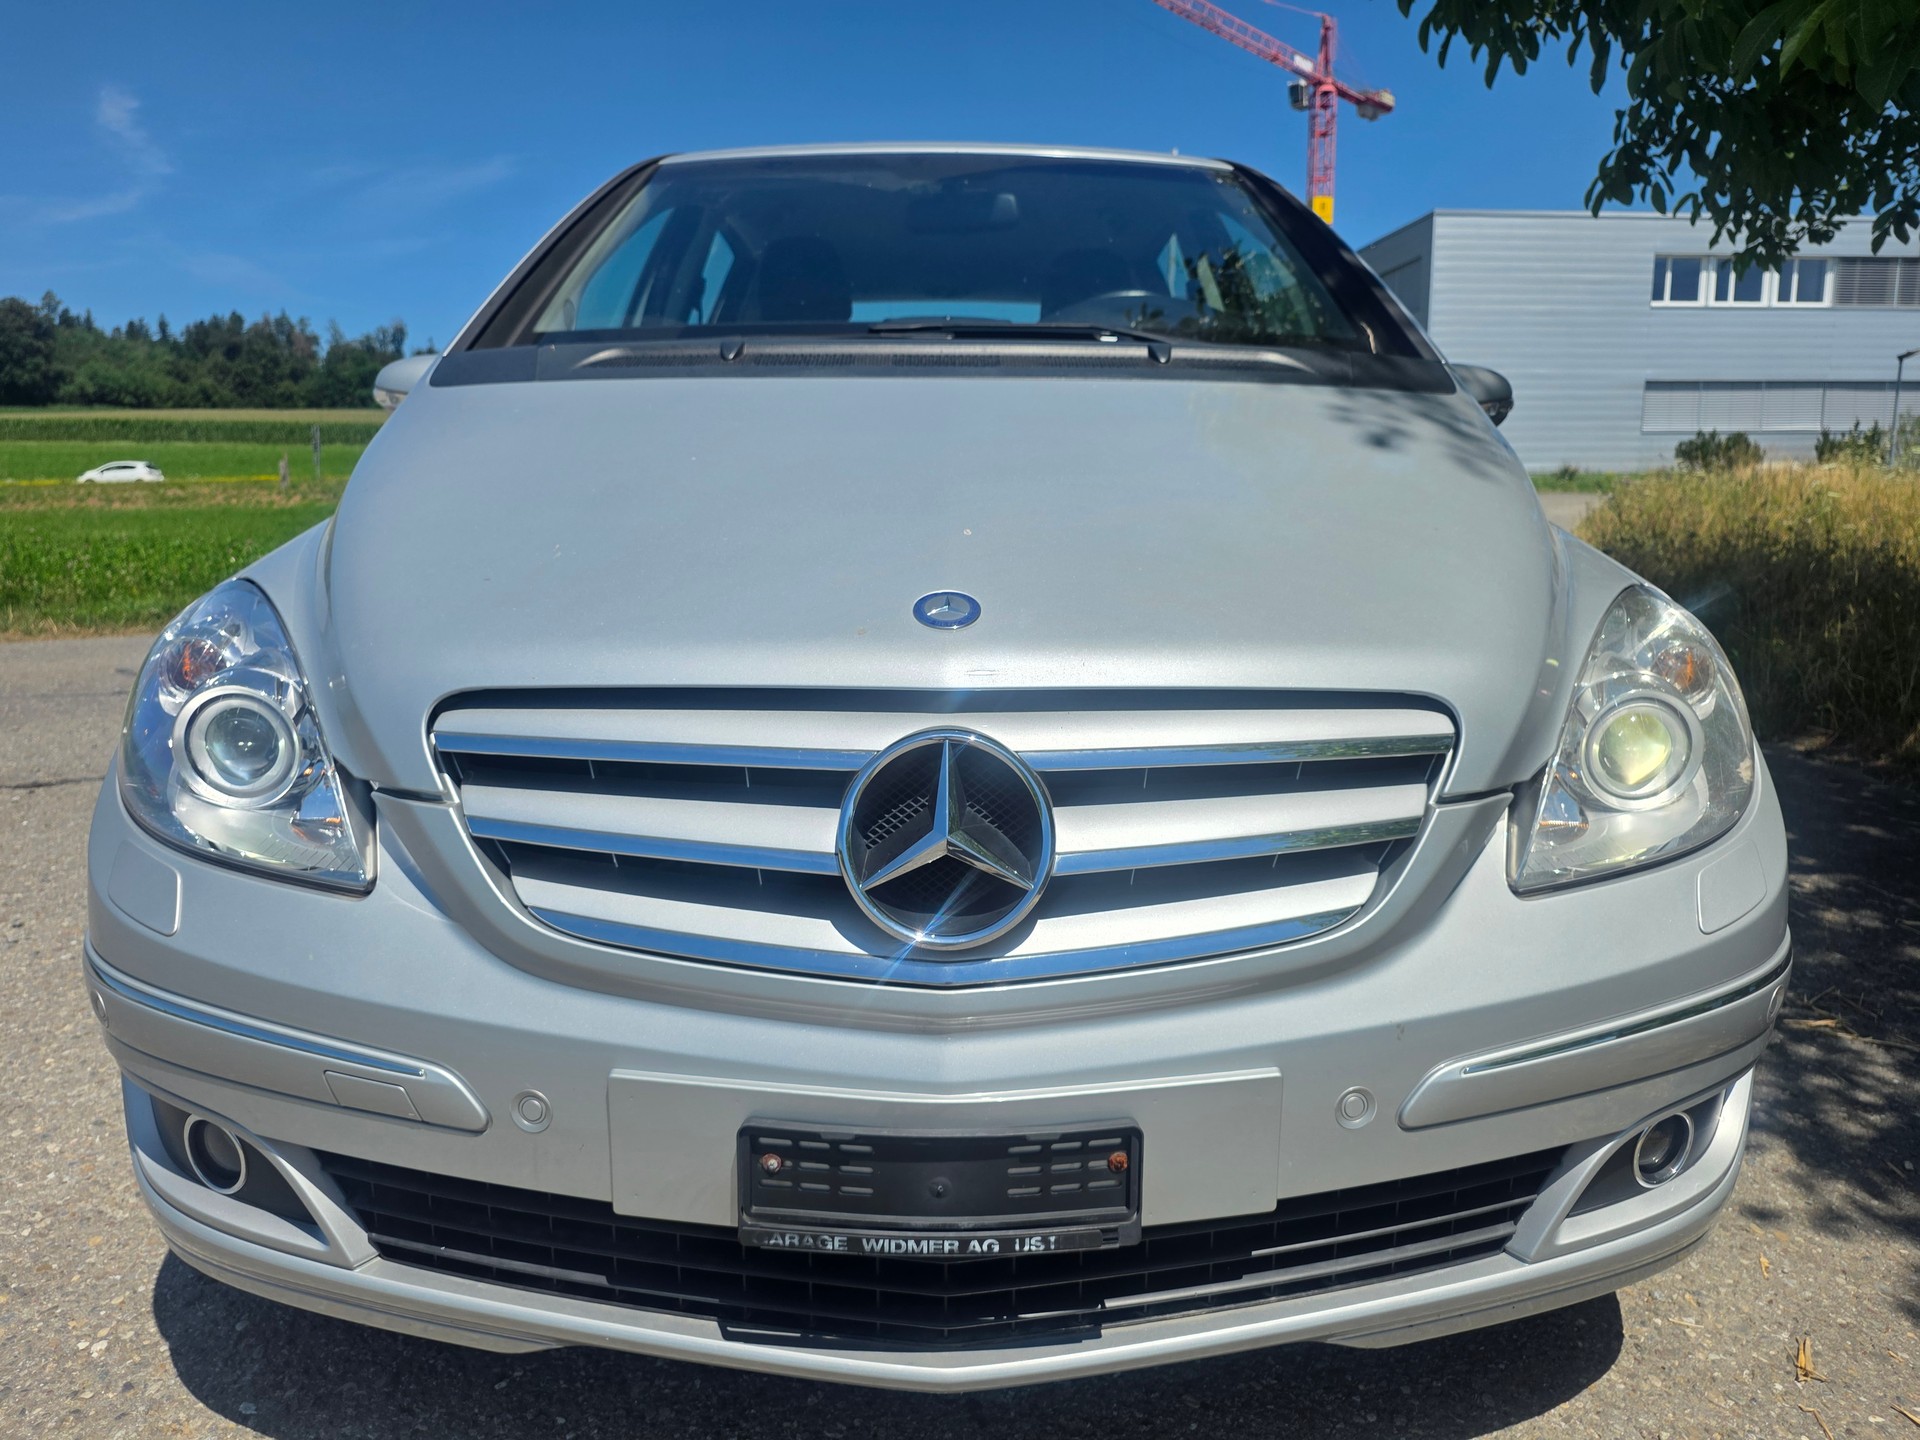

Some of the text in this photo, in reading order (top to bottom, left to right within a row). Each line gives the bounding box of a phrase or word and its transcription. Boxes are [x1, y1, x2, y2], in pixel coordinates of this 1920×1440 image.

[752, 1232, 848, 1250] ARAGE
[861, 1237, 959, 1254] WIDMER
[966, 1238, 1000, 1254] AG
